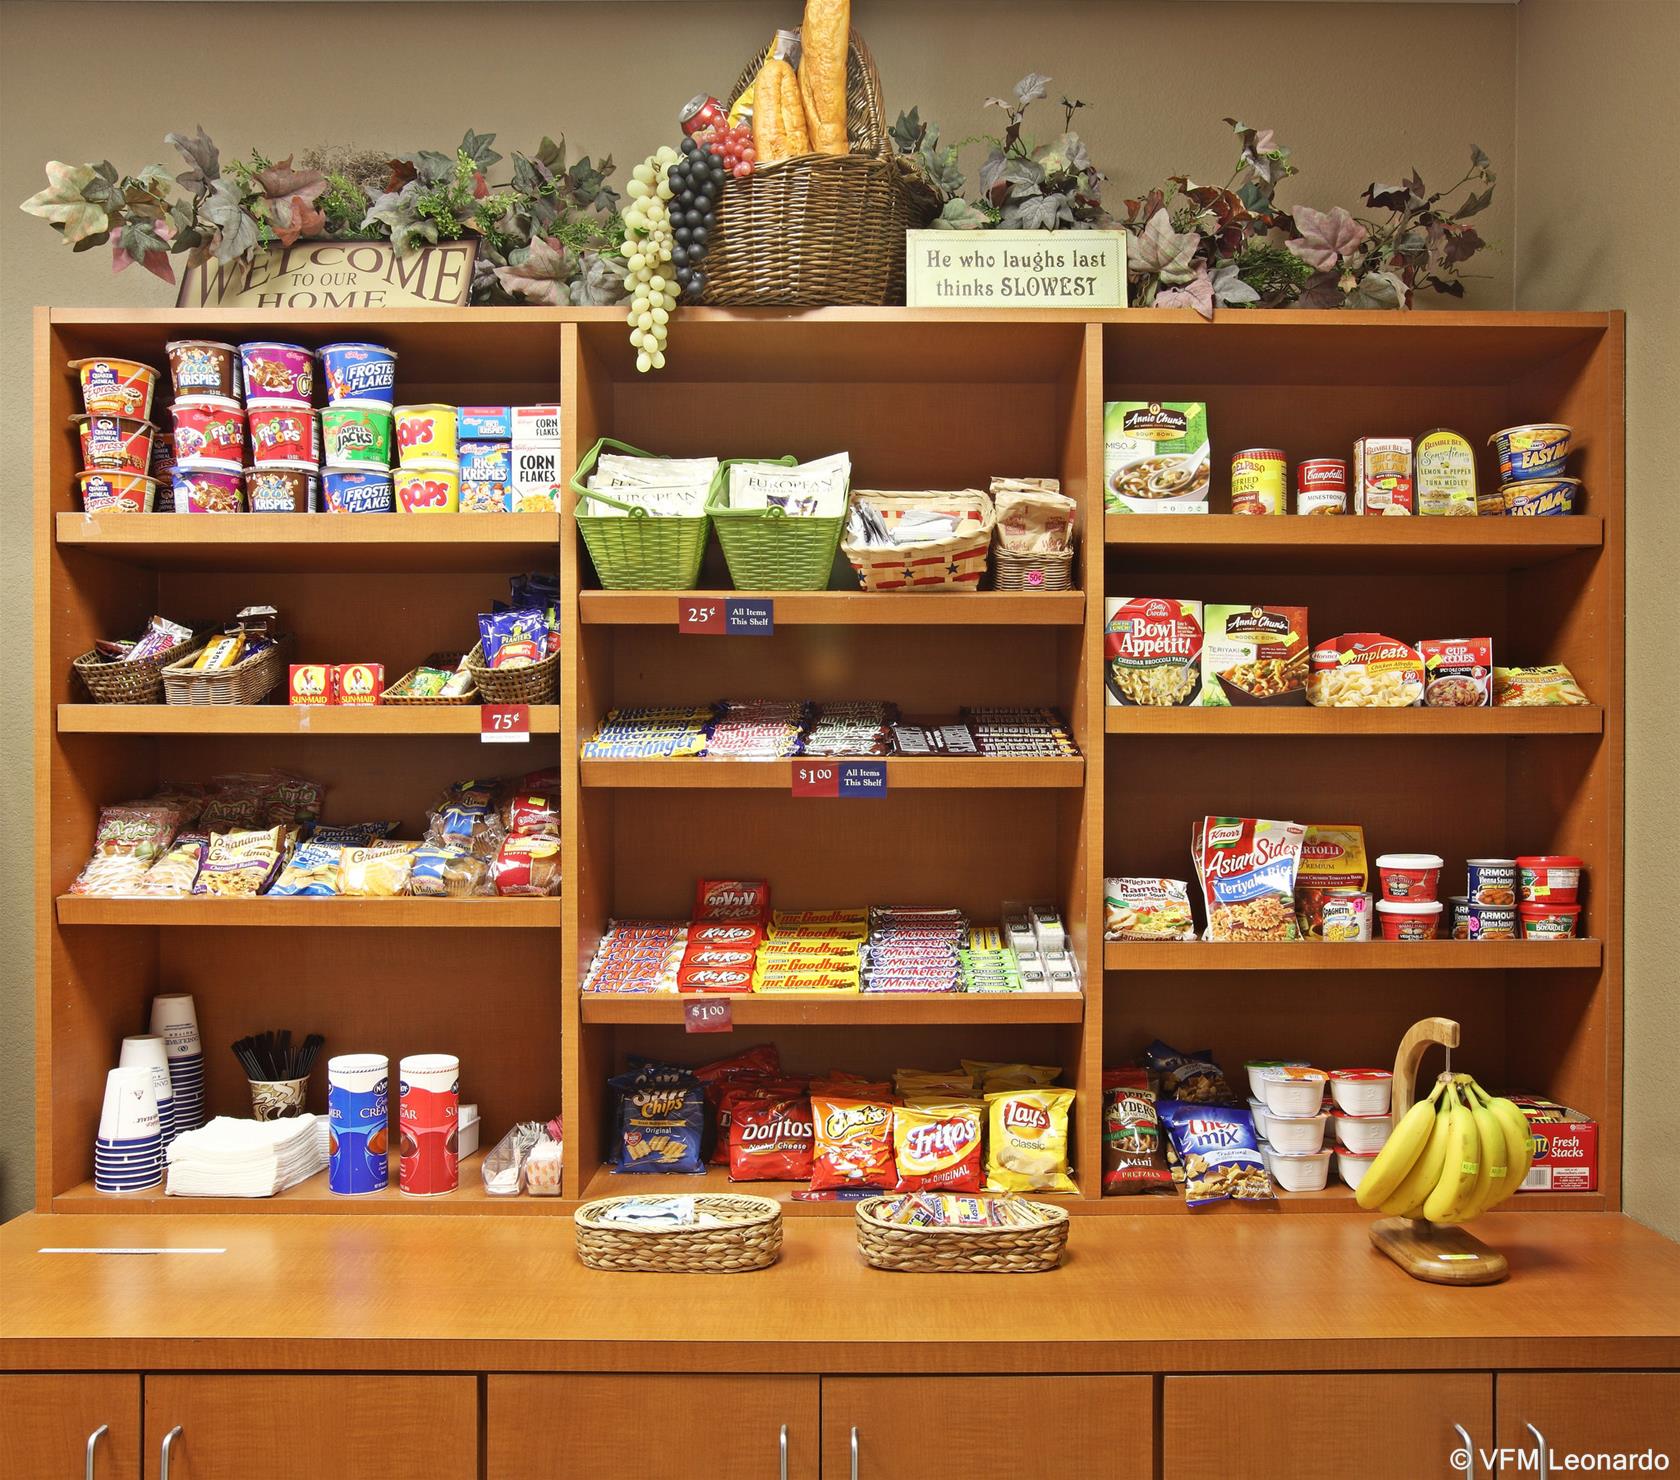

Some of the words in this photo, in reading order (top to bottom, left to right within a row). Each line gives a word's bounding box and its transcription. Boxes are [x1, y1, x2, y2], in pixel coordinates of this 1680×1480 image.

[926, 249, 952, 268] He
[959, 249, 996, 269] who
[1003, 249, 1065, 273] laughs
[1072, 249, 1107, 268] last
[200, 246, 468, 308] WELCOME
[292, 273, 313, 286] TO
[321, 271, 357, 285] OUR
[936, 278, 995, 297] thinks
[1001, 276, 1097, 297] SLOWEST
[257, 290, 387, 307] HOME
[181, 364, 213, 374] COCOA
[348, 361, 394, 379] FROSTED
[92, 372, 114, 380] QUAKER
[180, 373, 220, 386] KRISPIES
[351, 374, 392, 391] FLAKES
[536, 419, 558, 428] CORN
[1125, 412, 1156, 427] Annie
[1156, 412, 1187, 427] Chun's
[95, 429, 117, 437] QUAKER
[259, 420, 294, 438] FROOT
[536, 429, 559, 437] FLAKES
[265, 430, 301, 447] LOOPS
[336, 431, 372, 452] JACKS
[1105, 442, 1128, 450] MISO
[1366, 445, 1392, 455] BUMBLE
[1424, 440, 1448, 451] BUMBLE
[519, 455, 555, 470] CORN
[1521, 449, 1553, 469] EASY
[461, 468, 508, 482] KRISPIES
[519, 470, 556, 483] FLAKES
[1420, 468, 1441, 476] LEMON
[748, 477, 833, 489] EUROPEAN
[1232, 476, 1259, 487] FRIED
[1444, 479, 1469, 487] MEDLEY
[259, 489, 289, 498] COCOA
[399, 480, 450, 512] POPS
[254, 499, 295, 511] KRISPIES
[348, 497, 390, 512] FLAKES
[1511, 503, 1538, 515] EASY
[687, 606, 716, 623] 25¢
[732, 608, 744, 616] All
[745, 608, 767, 617] Items
[731, 617, 748, 626] This
[749, 617, 769, 627] Shelf
[1132, 618, 1177, 638] Bowl
[1229, 615, 1259, 630] Annie
[1258, 615, 1289, 629] Chun's
[501, 634, 532, 644] PLANTERS
[1118, 632, 1191, 657] Appétit!
[1207, 645, 1240, 654] TERIYAKI
[1343, 644, 1409, 666] ompleats
[1445, 646, 1467, 656] CUP
[1117, 657, 1144, 666] CHEDDAR
[1144, 657, 1171, 665] BROCCOLI
[1370, 662, 1393, 671] Chicken
[291, 695, 328, 704] SUN-MAID
[341, 695, 376, 704] SUN-MAID
[492, 712, 520, 730] 75¢
[846, 769, 858, 777] All
[859, 769, 880, 778] Items
[843, 778, 862, 787] This
[863, 778, 882, 788] Shelf
[1209, 829, 1241, 842] Knorr
[1255, 838, 1300, 866] Sides
[1300, 845, 1340, 856] RTOLLI
[1205, 851, 1256, 878] Asian
[1298, 858, 1335, 870] PREMIUM
[1479, 868, 1514, 877] ARMOUR
[1120, 884, 1167, 895] Ramen
[801, 911, 858, 923] Goodbar
[1479, 911, 1514, 920] ARMOUR
[702, 927, 750, 939] KitKat
[775, 929, 798, 938] mr.
[797, 927, 857, 938] Goodbar
[894, 929, 961, 940] Musketeers
[766, 944, 788, 953] mr.
[788, 942, 848, 954] Goodbar
[884, 948, 951, 958] Musketeers
[696, 951, 746, 963] KitKat
[887, 959, 956, 967] Musketeers
[766, 962, 788, 971] mr.
[788, 958, 847, 972] Goodbar
[692, 971, 744, 983] KitKat
[885, 967, 956, 977] Musketeers
[761, 978, 785, 987] mr.
[785, 975, 844, 987] Goodbar
[884, 978, 953, 988] Musketeers
[632, 1089, 688, 1108] Sun
[641, 1097, 685, 1119] Chips
[645, 1127, 672, 1136] Original
[741, 1118, 814, 1141] Doritos
[1187, 1119, 1238, 1136] Chex
[907, 1117, 977, 1158] Fritos
[1196, 1129, 1240, 1148] mix
[777, 1142, 807, 1151] Cheese
[1010, 1138, 1046, 1151] Classic
[1534, 1138, 1550, 1154] ITZ
[1552, 1136, 1579, 1147] Fresh
[1551, 1147, 1583, 1158] Stacks
[1127, 1157, 1152, 1167] Mini
[932, 1164, 971, 1184] ORIGINAL
[1121, 1171, 1161, 1179] PRETZELS
